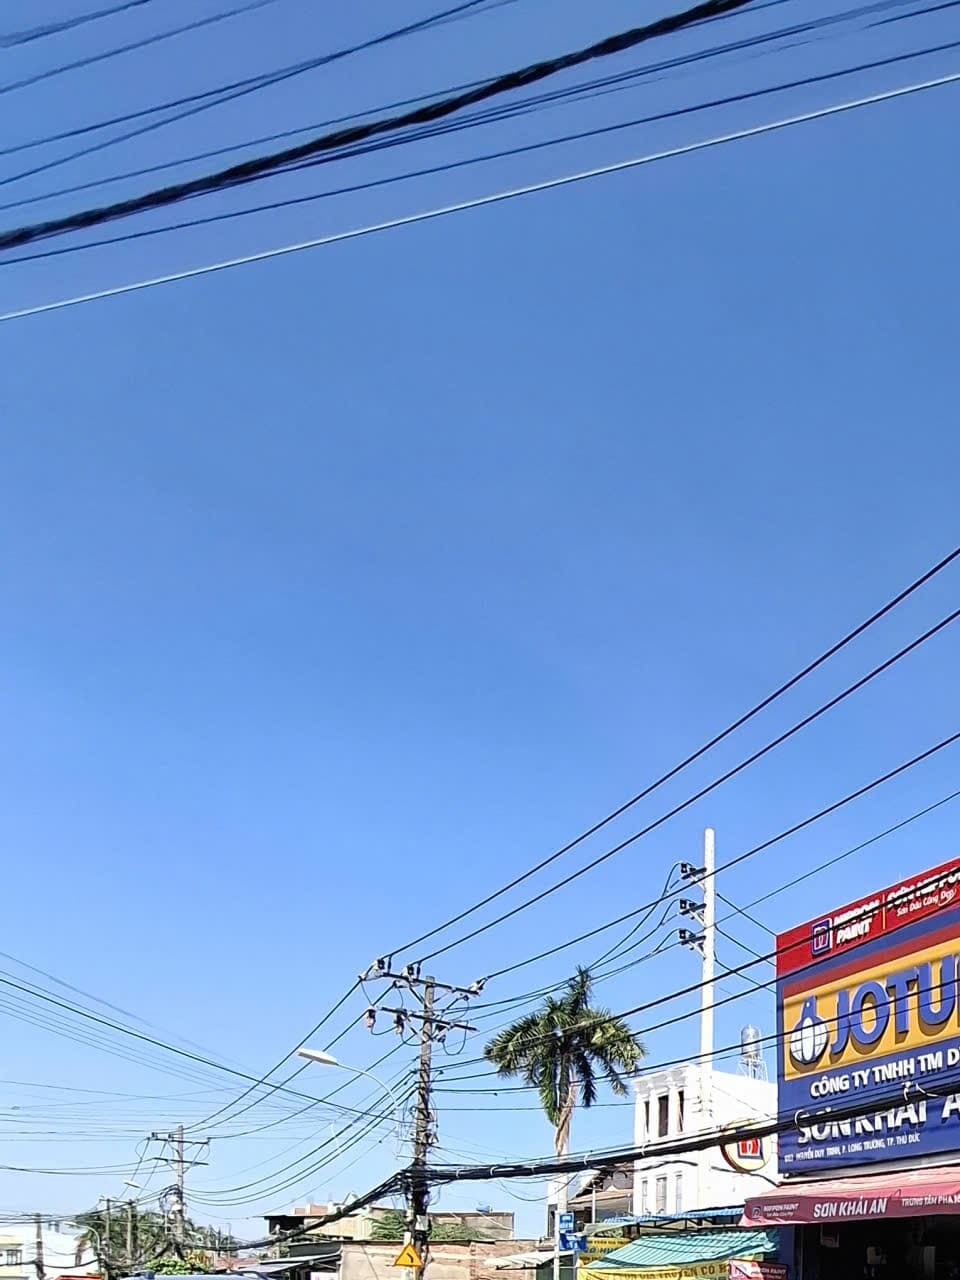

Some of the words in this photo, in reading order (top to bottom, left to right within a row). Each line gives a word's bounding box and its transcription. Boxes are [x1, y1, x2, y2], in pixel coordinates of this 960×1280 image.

[836, 917, 872, 944] PAINT
[810, 1075, 850, 1097] CÔNG
[853, 1070, 873, 1087] TY
[871, 1059, 915, 1081] TNHH
[917, 1053, 943, 1071] TM
[848, 1142, 863, 1153] LONG
[813, 1202, 836, 1218] SƠN
[838, 1195, 868, 1217] KHẢI
[869, 1198, 888, 1214] AN
[937, 1195, 953, 1204] PHA
